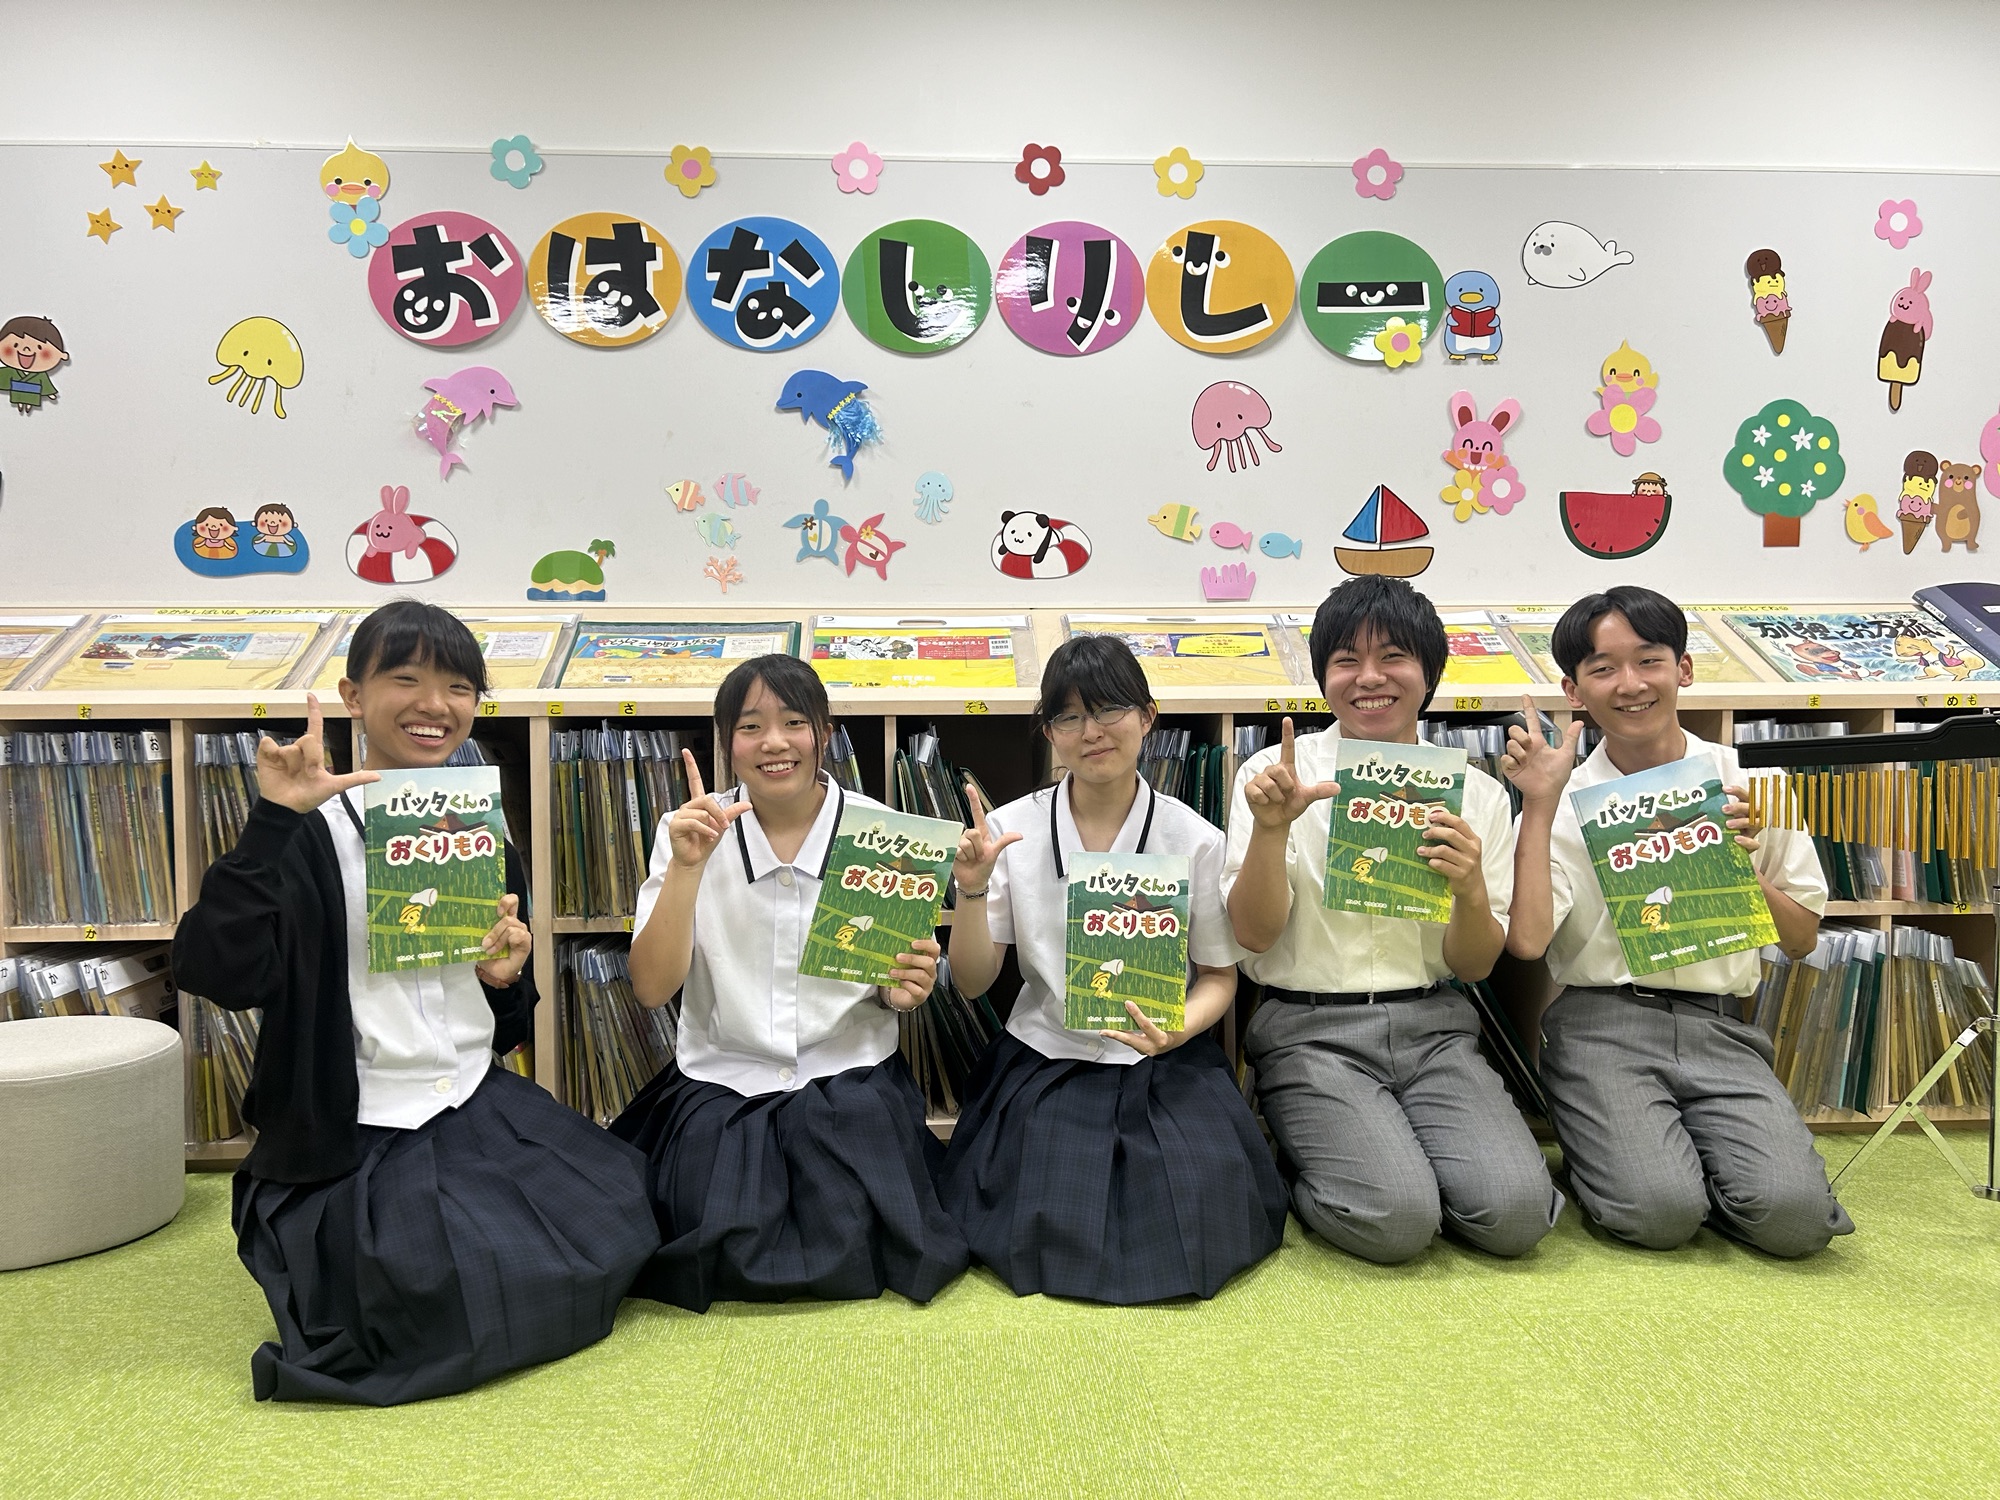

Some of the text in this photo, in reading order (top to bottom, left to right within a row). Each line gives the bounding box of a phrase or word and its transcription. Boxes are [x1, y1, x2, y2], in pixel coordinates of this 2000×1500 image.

[391, 221, 1431, 353] おはなしリレー
[253, 704, 267, 717] か
[485, 703, 498, 716] け
[550, 704, 562, 715] こ
[623, 703, 635, 715] さ
[1809, 696, 1819, 707] ま
[1946, 695, 1959, 707] め
[1967, 695, 1977, 707] も
[1356, 761, 1451, 786] バッタくんの
[390, 790, 490, 813] バッタくんの
[1599, 789, 1704, 825] バッタくんの
[390, 834, 493, 861] おくりもの
[856, 829, 945, 860] バッタくんの
[1610, 824, 1719, 869] おくりもの
[844, 868, 936, 898] おくりもの
[1088, 872, 1177, 893] バッタくんの
[1955, 902, 1968, 914] や
[85, 928, 97, 940] か
[1086, 912, 1177, 936] おくりもの
